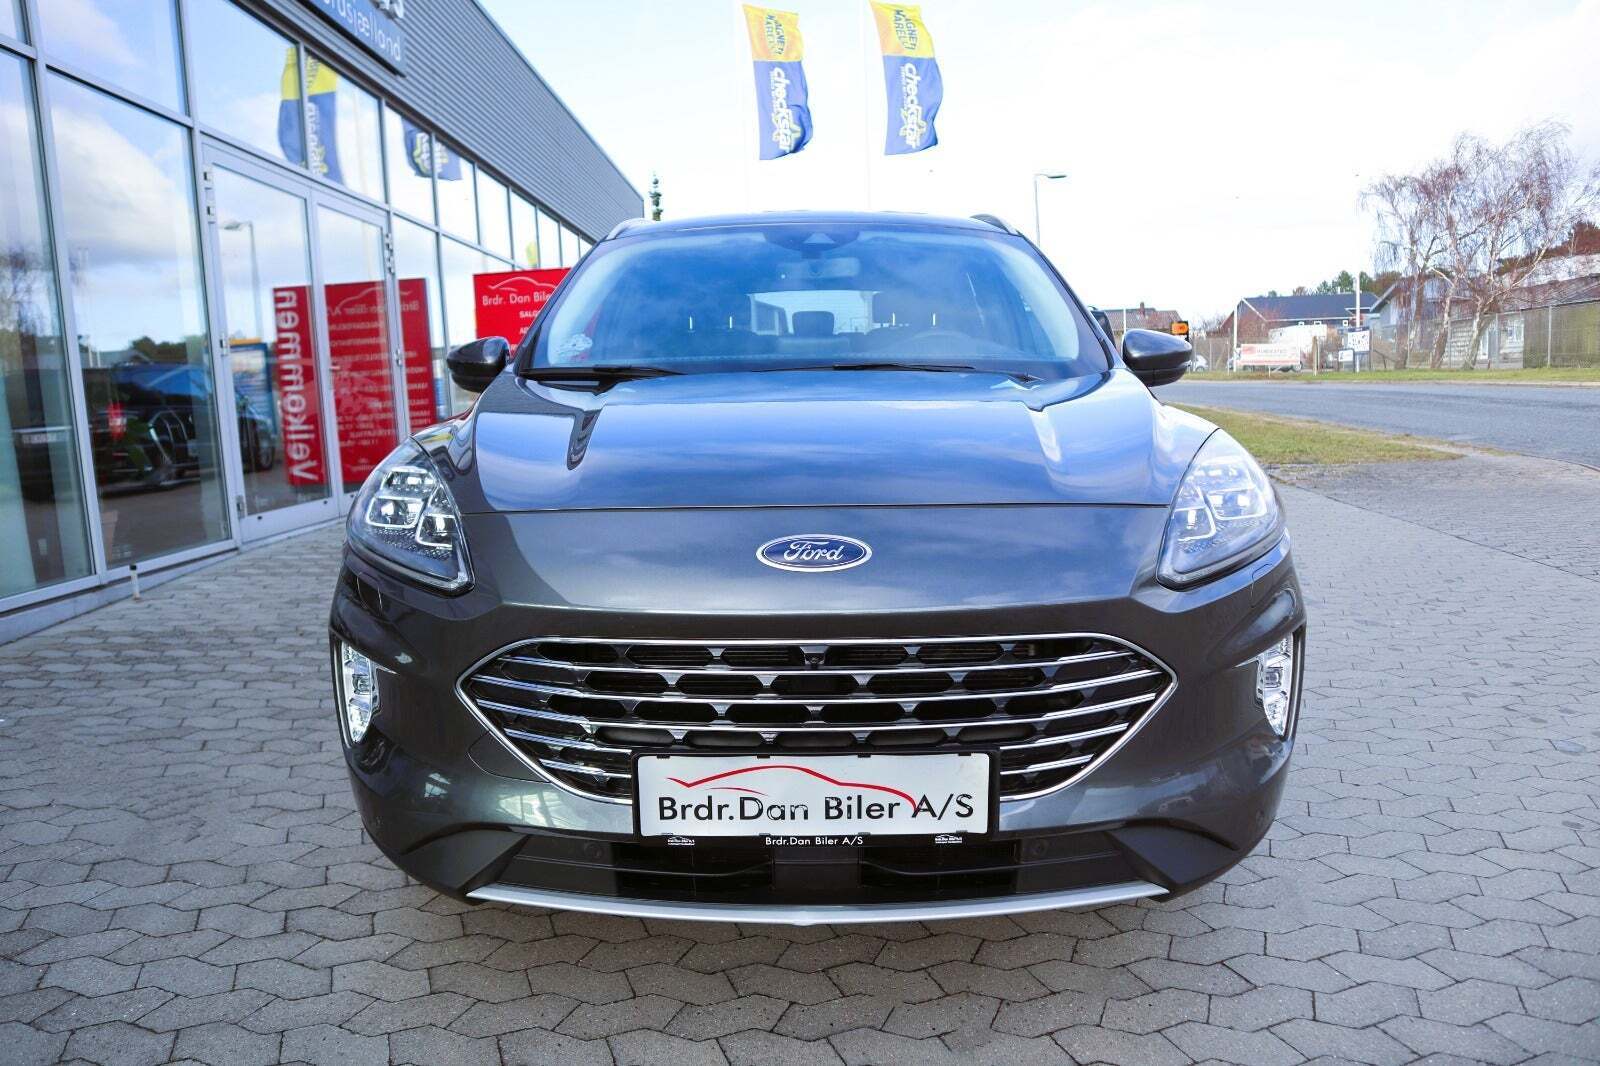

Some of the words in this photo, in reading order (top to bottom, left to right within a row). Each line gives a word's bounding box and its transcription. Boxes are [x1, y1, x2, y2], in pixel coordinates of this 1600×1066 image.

[509, 293, 531, 305] Dan
[533, 291, 551, 303] Bile
[783, 540, 845, 561] Ford
[824, 795, 900, 821] Biler
[911, 794, 974, 821] A/S
[815, 836, 838, 846] Biler
[842, 836, 864, 846] A/S
